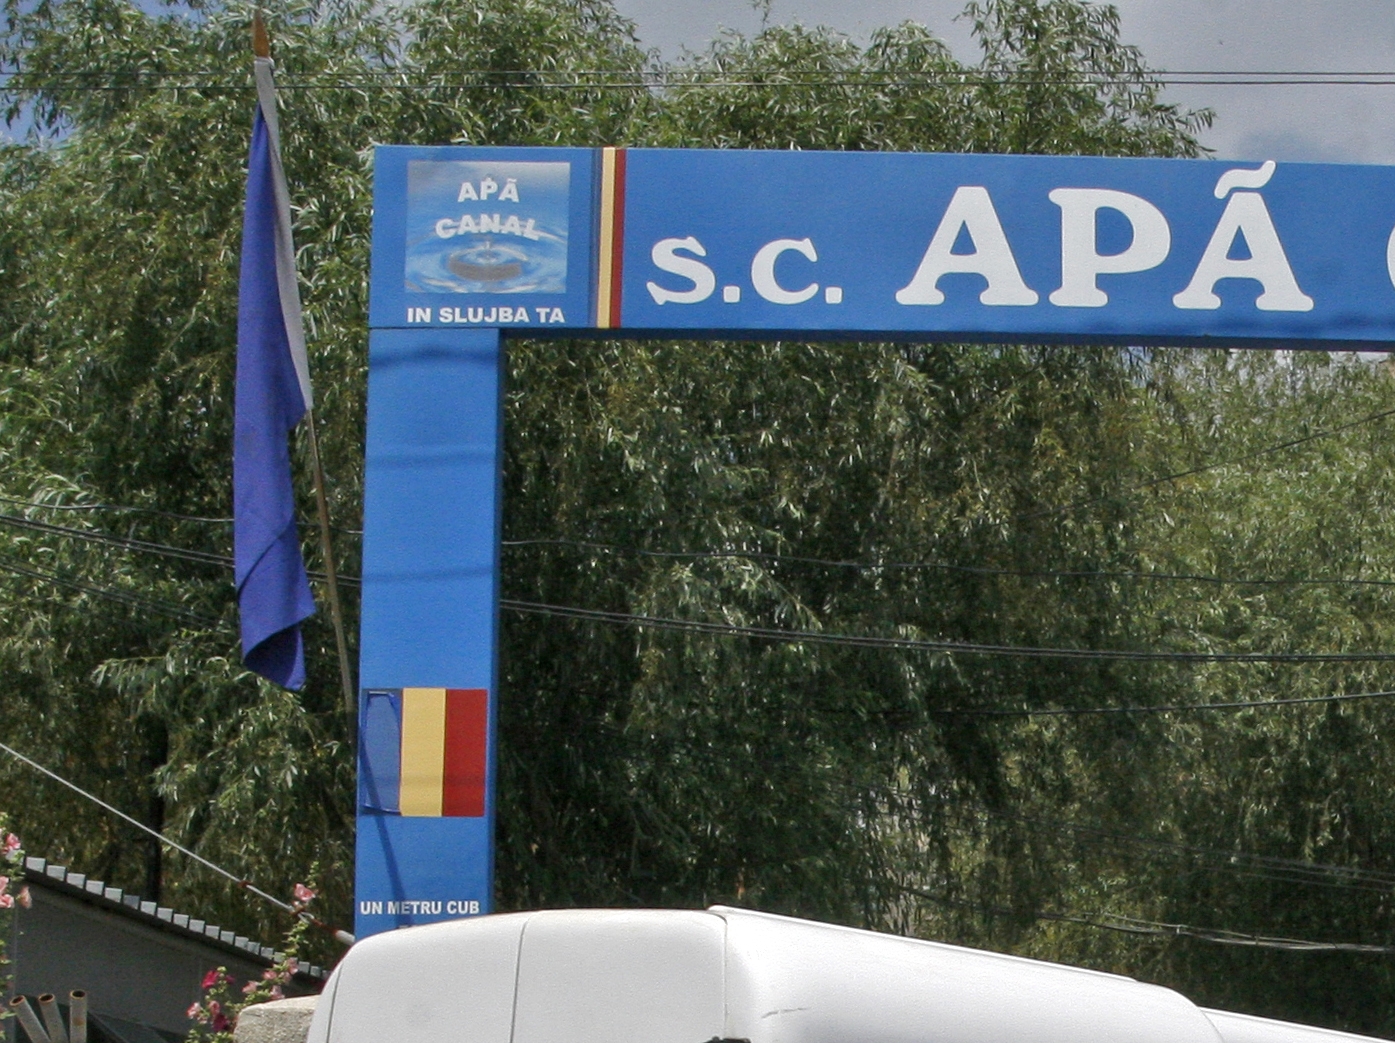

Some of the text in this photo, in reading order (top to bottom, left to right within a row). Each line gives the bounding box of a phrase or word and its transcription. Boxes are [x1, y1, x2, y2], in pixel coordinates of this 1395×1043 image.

[435, 213, 539, 241] CANAL
[646, 236, 842, 304] S.C.
[407, 307, 565, 323] IN SLUJBA TA
[360, 901, 480, 915] UN METRU CUB
